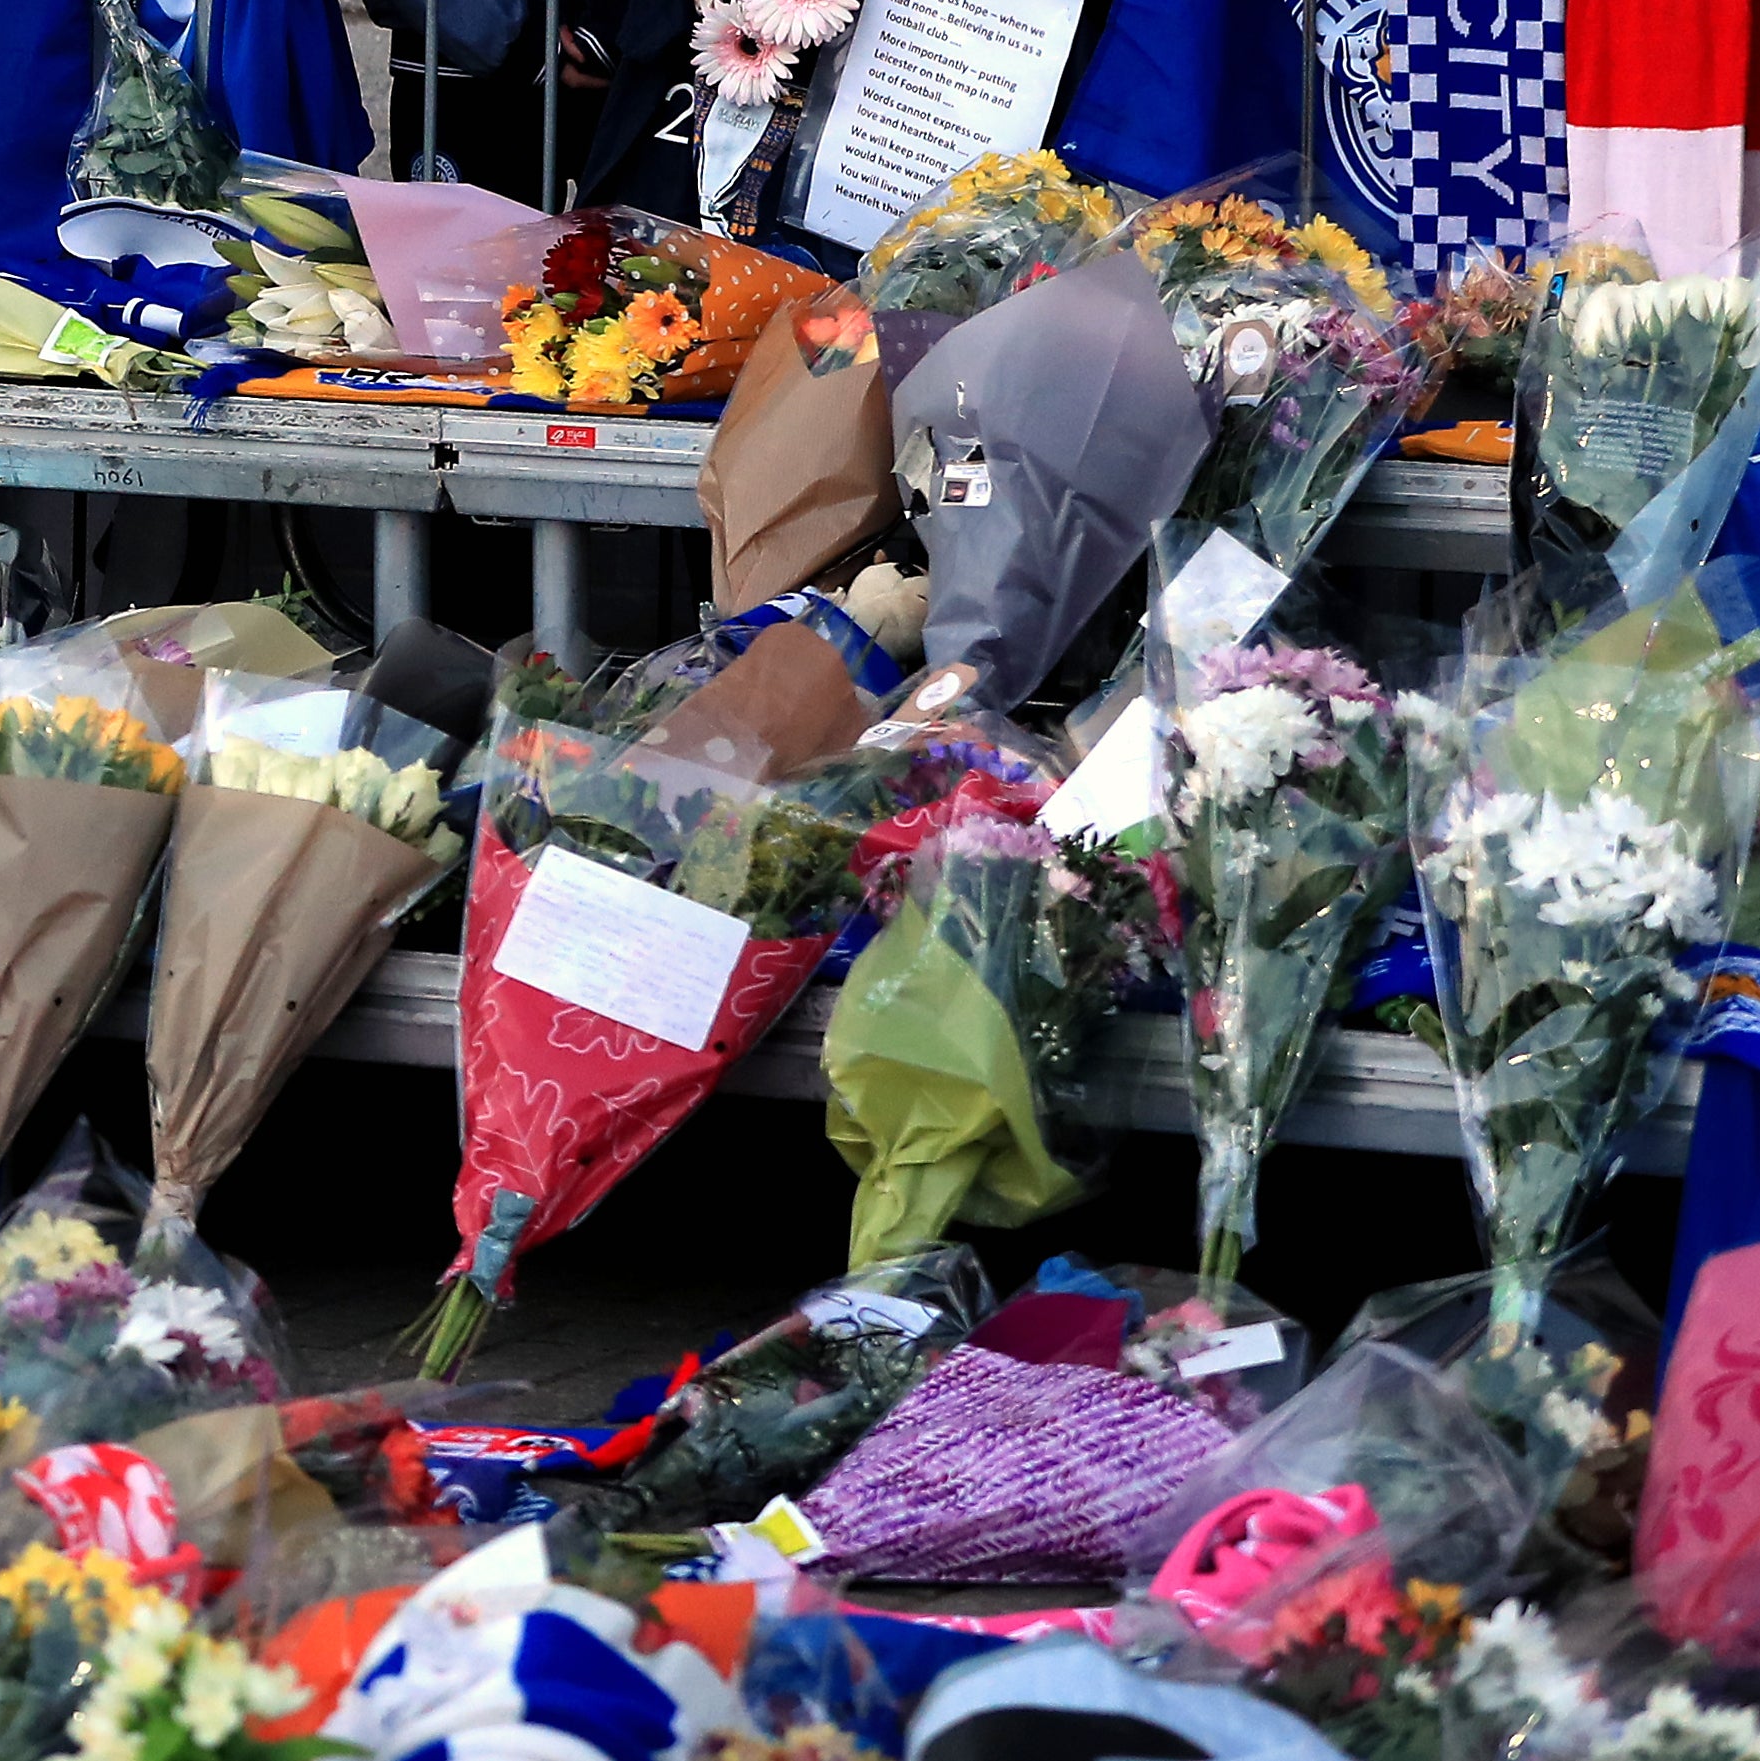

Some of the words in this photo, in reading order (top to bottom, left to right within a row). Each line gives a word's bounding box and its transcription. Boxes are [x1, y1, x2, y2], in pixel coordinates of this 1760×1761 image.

[885, 9, 926, 34] football
[926, 25, 950, 42] club
[912, 3, 939, 19] none
[996, 31, 1007, 45] in
[1008, 38, 1021, 50] us
[1022, 42, 1034, 54] as
[1035, 47, 1043, 57] a
[999, 14, 1029, 32] when
[1030, 27, 1046, 39] we
[873, 48, 918, 73] Leicester
[920, 66, 933, 79] on
[935, 69, 953, 86] the
[954, 80, 977, 97] map
[979, 88, 990, 100] in
[991, 95, 1013, 110] and
[879, 30, 907, 50] More
[908, 40, 970, 74] importantly
[979, 70, 1018, 93] putting
[868, 67, 886, 82] out
[888, 72, 901, 86] of
[900, 78, 943, 103] Football
[856, 104, 880, 121] love
[879, 113, 900, 129] and
[900, 121, 957, 152] heartbreak
[862, 86, 895, 108] Words
[896, 101, 931, 122] cannot
[933, 116, 971, 138] express
[973, 131, 992, 145] our
[844, 143, 877, 163] would
[879, 155, 903, 174] have
[850, 124, 868, 140] We
[869, 131, 888, 148] will
[888, 137, 914, 159] keep
[915, 151, 949, 174] strong
[835, 183, 882, 209] Heartfelt
[839, 162, 860, 180] You
[860, 172, 879, 188] will
[880, 178, 900, 196] live
